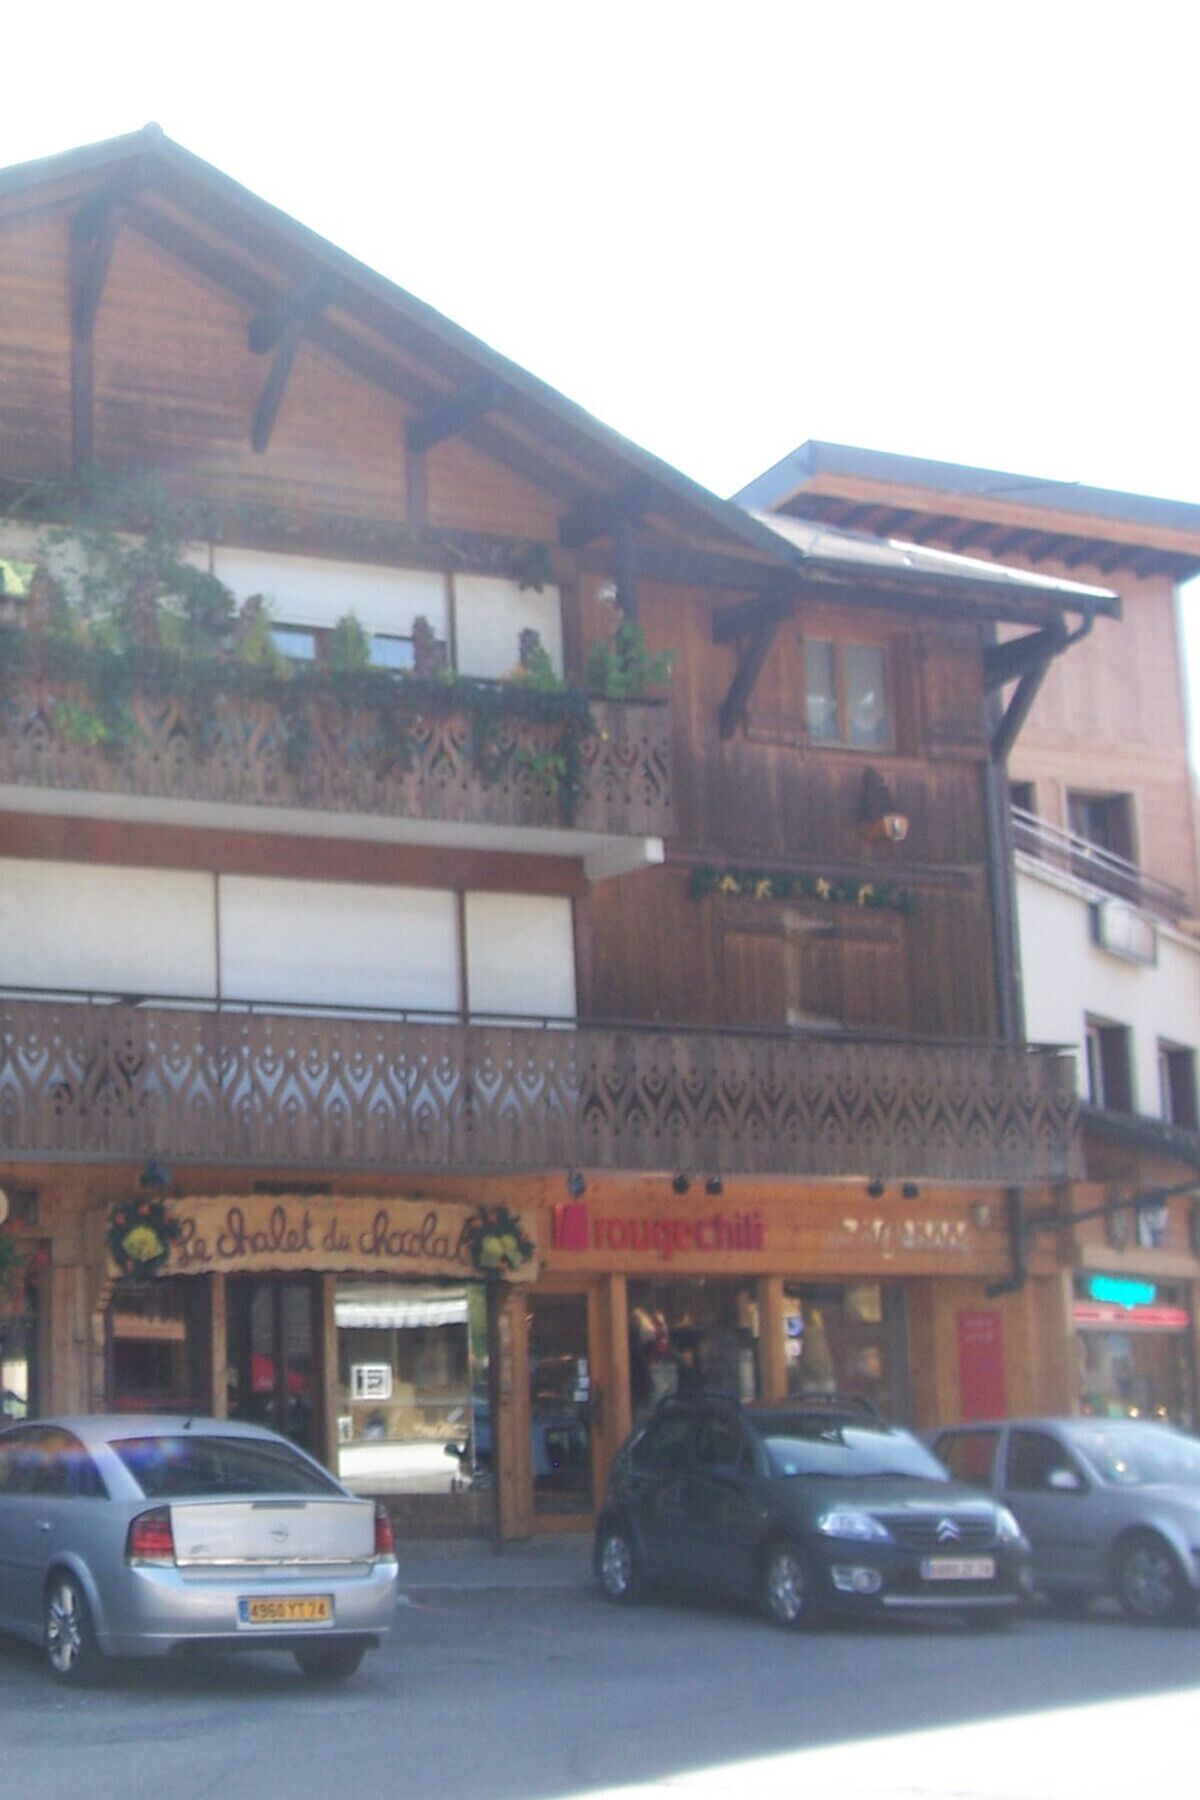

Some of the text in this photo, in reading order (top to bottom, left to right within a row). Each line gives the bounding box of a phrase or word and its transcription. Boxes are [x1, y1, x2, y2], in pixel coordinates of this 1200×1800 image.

[216, 1204, 314, 1257] chalet
[322, 1216, 351, 1252] du
[593, 1210, 766, 1263] rougechili
